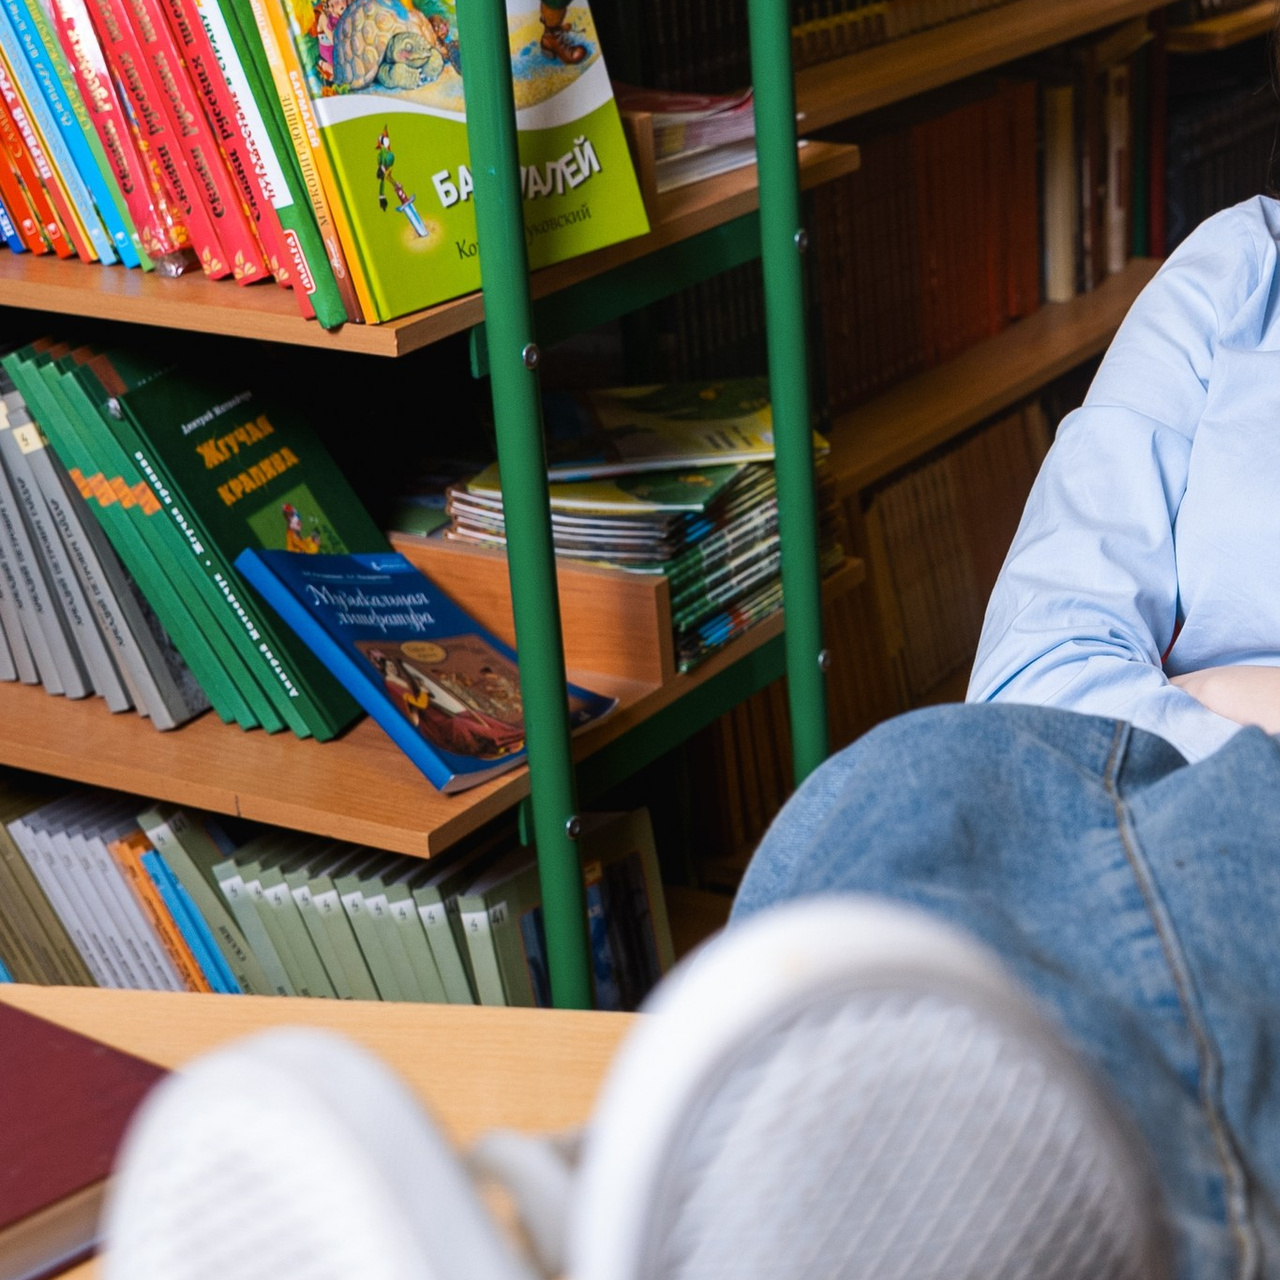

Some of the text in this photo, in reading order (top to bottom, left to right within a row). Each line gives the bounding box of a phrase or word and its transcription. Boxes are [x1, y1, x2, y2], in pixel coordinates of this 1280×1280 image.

[200, 13, 227, 70] СТРАНУ
[150, 48, 199, 138] русских
[287, 70, 320, 148] БАРМАЛЕЙ
[12, 106, 51, 180] ПЕРВЫЙ
[99, 118, 136, 194] Сказки
[278, 92, 331, 227] МЛЕКОПИТАЮЩИЕ
[431, 134, 602, 209] БААЛЕЙ
[187, 144, 228, 220] Сказки
[526, 203, 592, 246] уковский
[217, 447, 300, 507] КРАПИВА
[133, 448, 299, 699] Дмитрий Матвейчук Жгучая крапива
